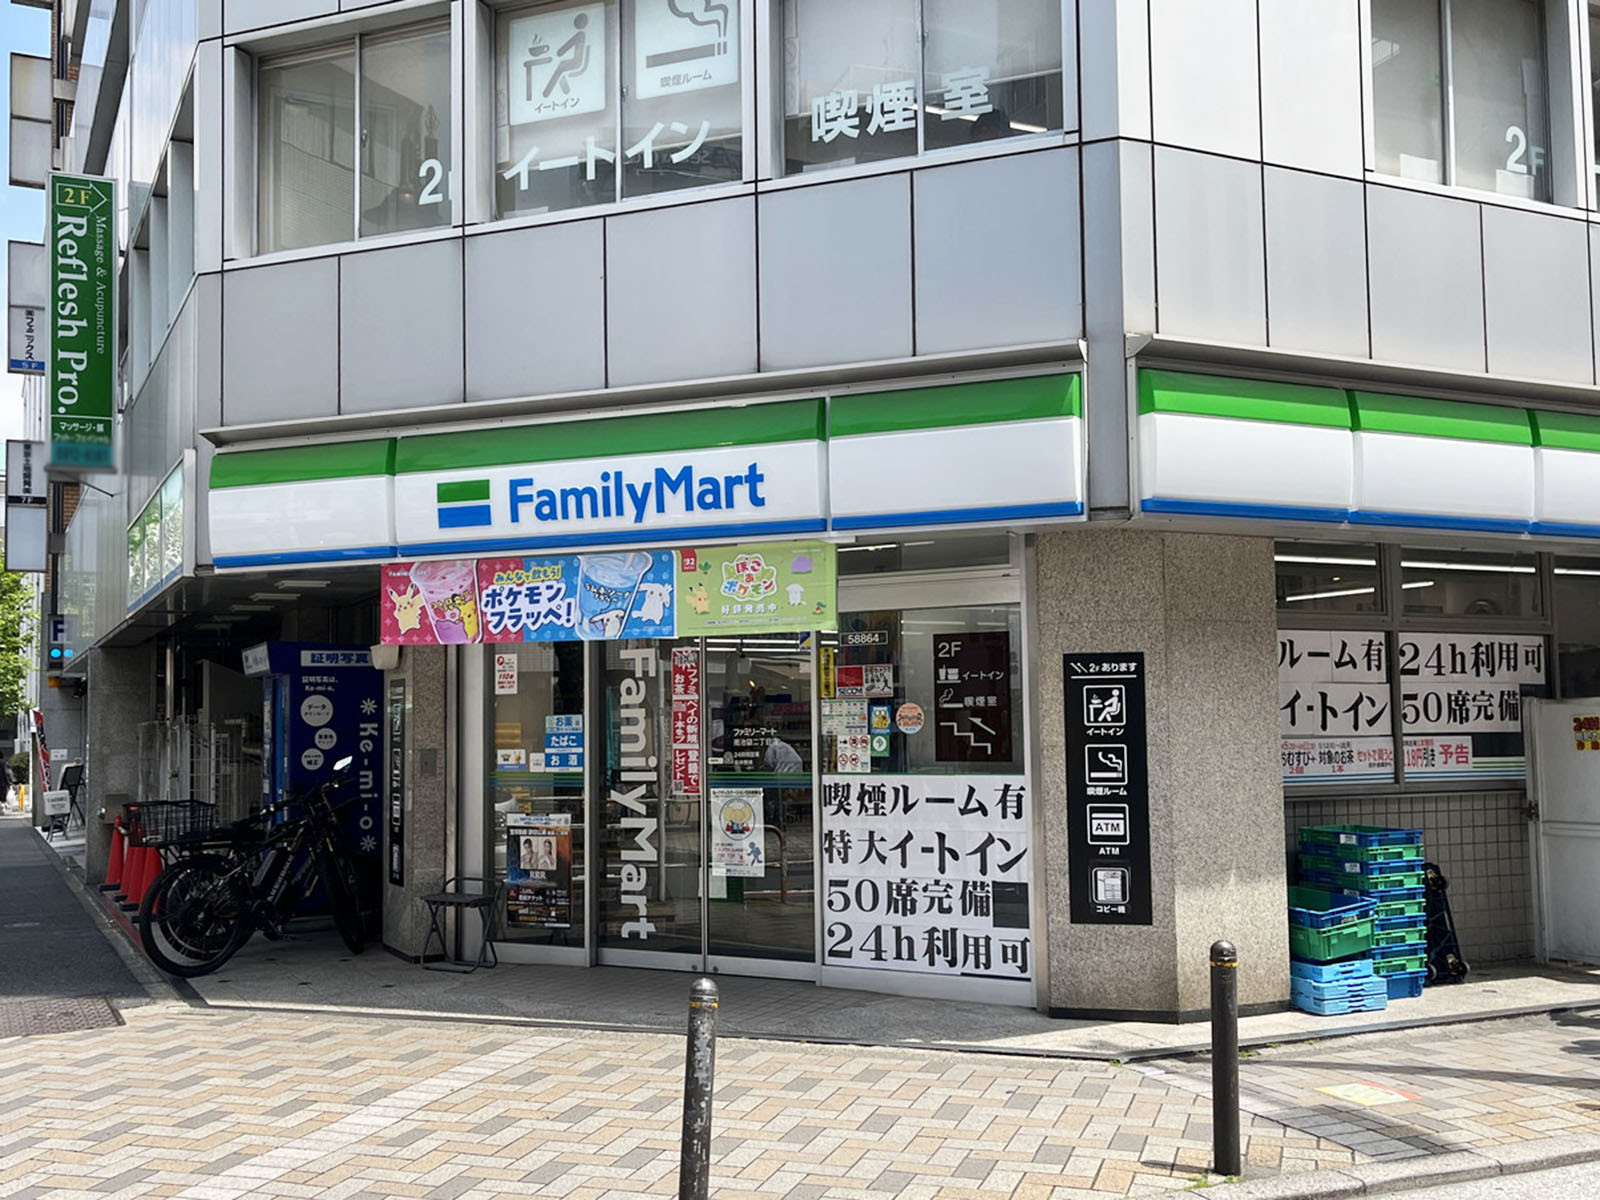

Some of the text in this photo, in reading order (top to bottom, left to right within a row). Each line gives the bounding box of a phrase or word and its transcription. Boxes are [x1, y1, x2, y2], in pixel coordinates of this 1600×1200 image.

[660, 71, 712, 88] 喫煙ルーム
[534, 97, 580, 113] イートイン
[811, 66, 993, 144] 喫煙室
[502, 120, 711, 191] イートイン
[1505, 125, 1544, 176] 2F
[63, 188, 92, 205] 2F
[419, 158, 452, 205] 2
[94, 214, 107, 264] Massage
[57, 213, 88, 339] Reflesh
[94, 281, 107, 355] Acupuncture
[57, 350, 88, 414] Pro.
[509, 462, 766, 524] FamilyMart
[484, 584, 562, 610] ポケモン
[724, 579, 774, 596] ポケモン
[847, 633, 880, 644] 58864
[938, 641, 962, 658] 2F
[1278, 639, 1384, 672] ルーム有
[962, 671, 1004, 680] イートイン
[1399, 641, 1543, 678] 24h利用可
[1402, 690, 1520, 725] 50席完備
[550, 736, 577, 747] たばこ
[733, 727, 777, 737] ファミリーマート
[1086, 728, 1124, 736] イートイン
[1439, 743, 1470, 765] 予告
[610, 648, 658, 940] FamilyMart
[823, 782, 1026, 820] 喫煙ルーム有
[1086, 787, 1128, 796] 喫煙ルーム
[1095, 823, 1121, 833] ATM
[824, 829, 1028, 876] 特大イートイン
[1098, 847, 1120, 856] ATM
[826, 878, 992, 917] 50席完備
[826, 922, 1031, 974] 24h利用可
